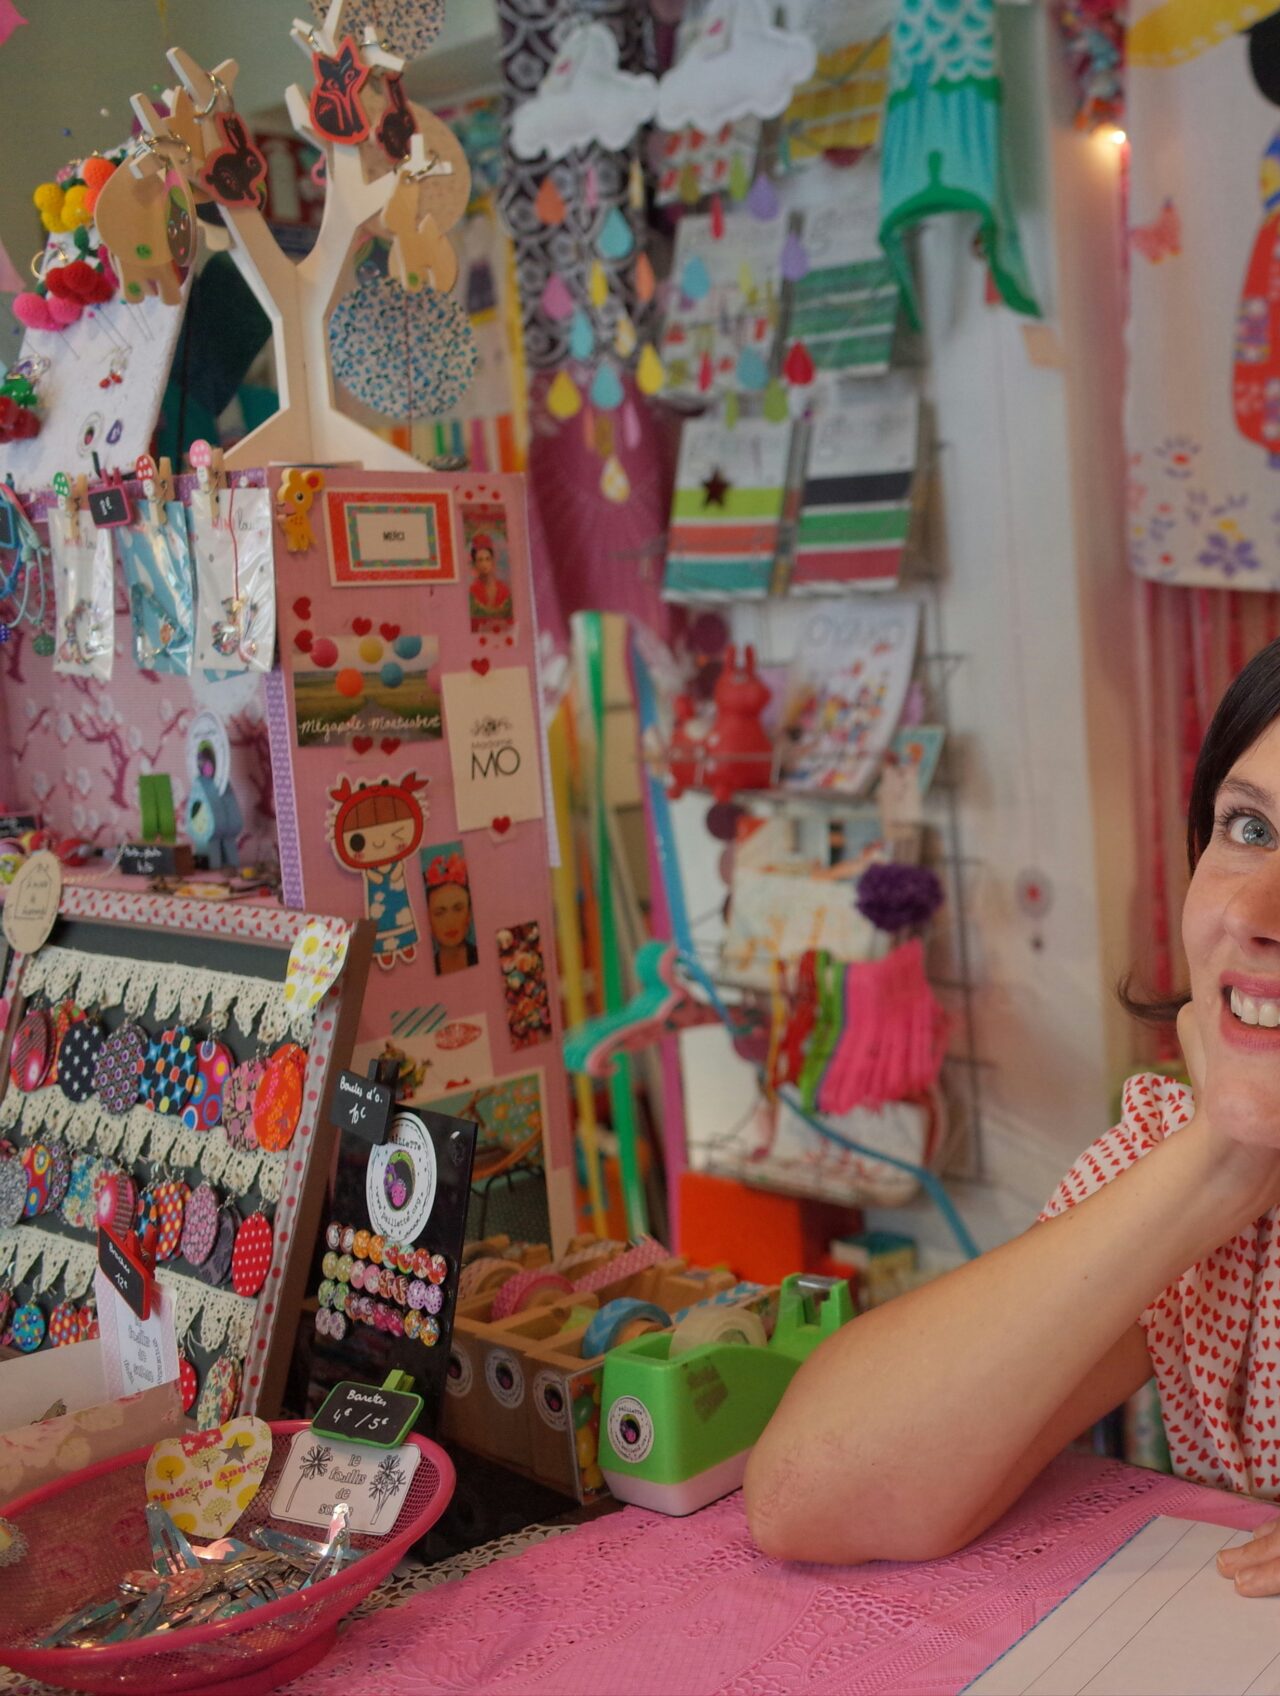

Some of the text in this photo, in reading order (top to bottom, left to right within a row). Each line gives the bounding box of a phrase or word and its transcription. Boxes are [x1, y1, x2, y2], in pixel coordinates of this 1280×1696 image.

[471, 747, 521, 781] MO
[152, 1456, 268, 1502] Made in Angers
